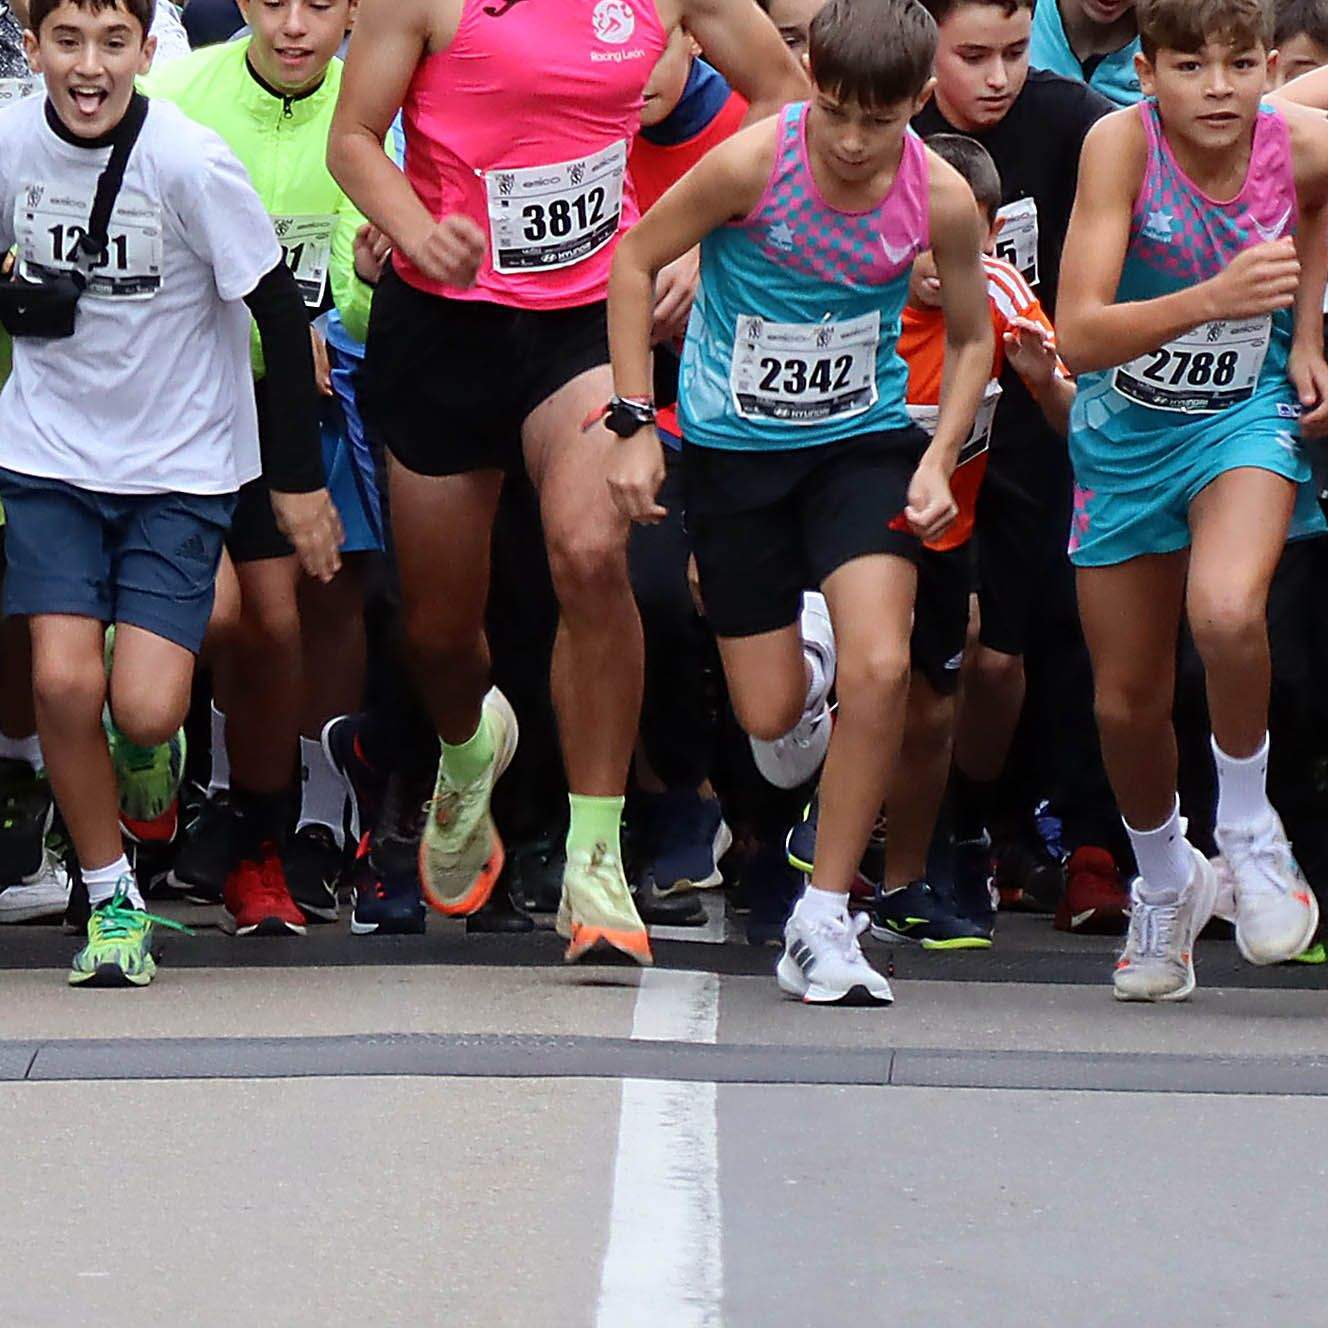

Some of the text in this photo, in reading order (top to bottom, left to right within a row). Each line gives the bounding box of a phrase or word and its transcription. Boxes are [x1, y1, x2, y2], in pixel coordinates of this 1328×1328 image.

[522, 186, 606, 242] 3812
[758, 354, 854, 395] 2342
[1142, 349, 1239, 386] 2788
